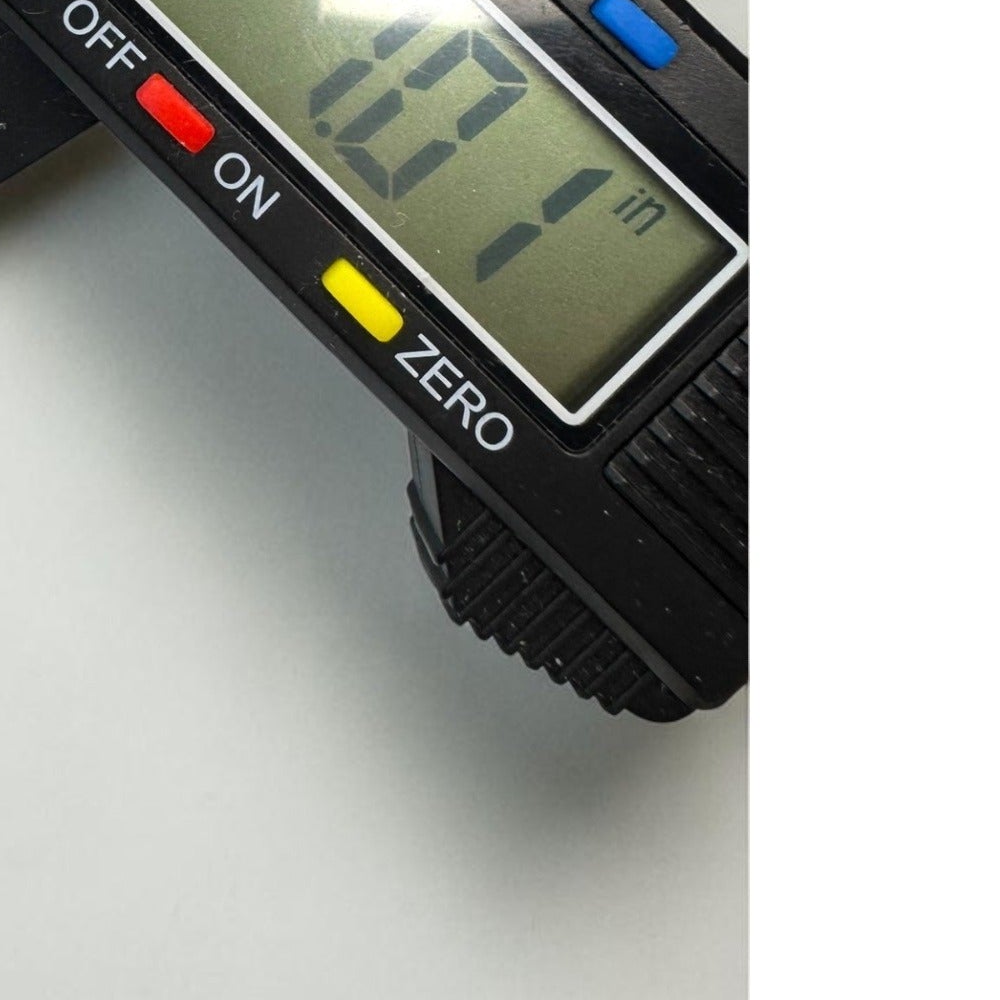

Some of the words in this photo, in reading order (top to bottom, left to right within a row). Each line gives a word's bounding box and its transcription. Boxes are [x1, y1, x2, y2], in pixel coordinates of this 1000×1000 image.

[212, 151, 281, 221] ON
[612, 186, 668, 237] in
[394, 333, 515, 452] ZERO
